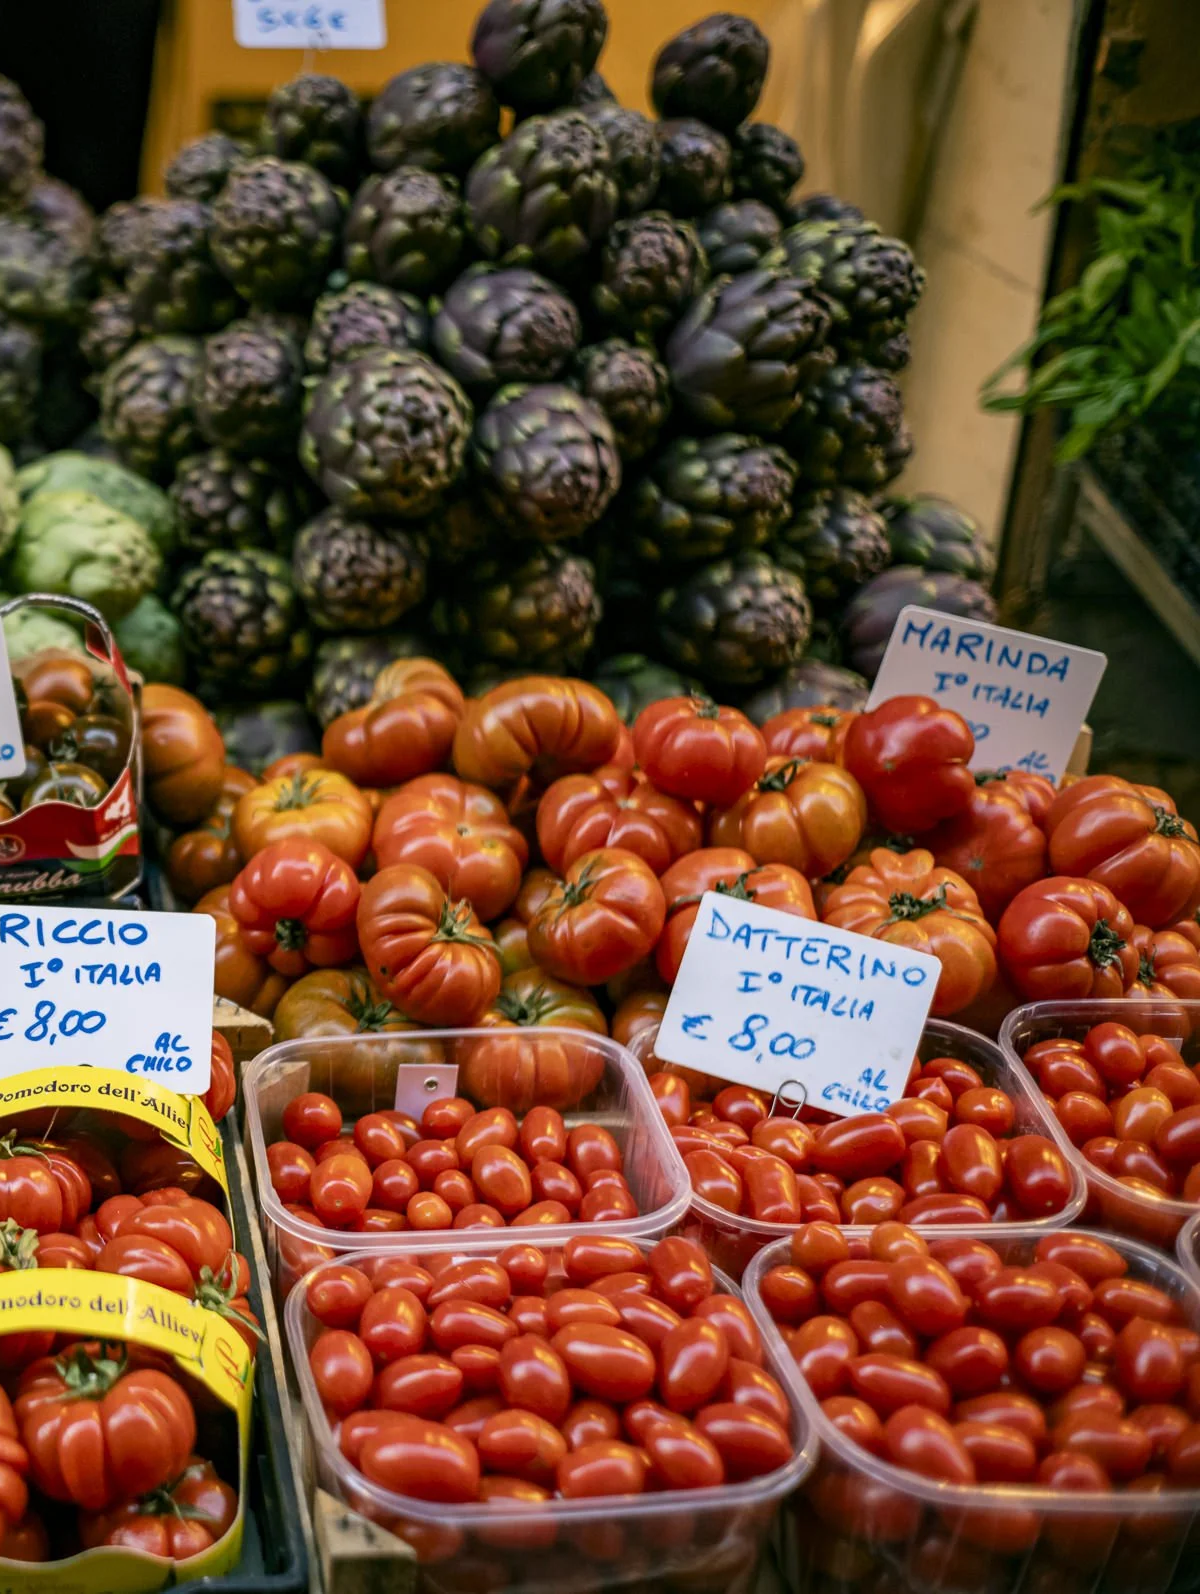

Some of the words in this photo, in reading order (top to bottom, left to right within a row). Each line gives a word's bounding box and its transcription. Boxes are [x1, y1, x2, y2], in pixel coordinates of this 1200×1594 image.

[902, 620, 1070, 682] MARINDA
[972, 683, 1050, 718] ITALIA
[706, 907, 927, 986] DATTERINO
[75, 962, 161, 985] ITALIA
[791, 985, 875, 1021] ITALIA
[24, 1000, 106, 1045] 8,00
[681, 1014, 714, 1040] €
[728, 1014, 816, 1063] 8,00
[154, 1032, 190, 1054] AL
[126, 1054, 192, 1073] CHILO
[858, 1067, 889, 1091] AL
[822, 1083, 890, 1113] CHILO
